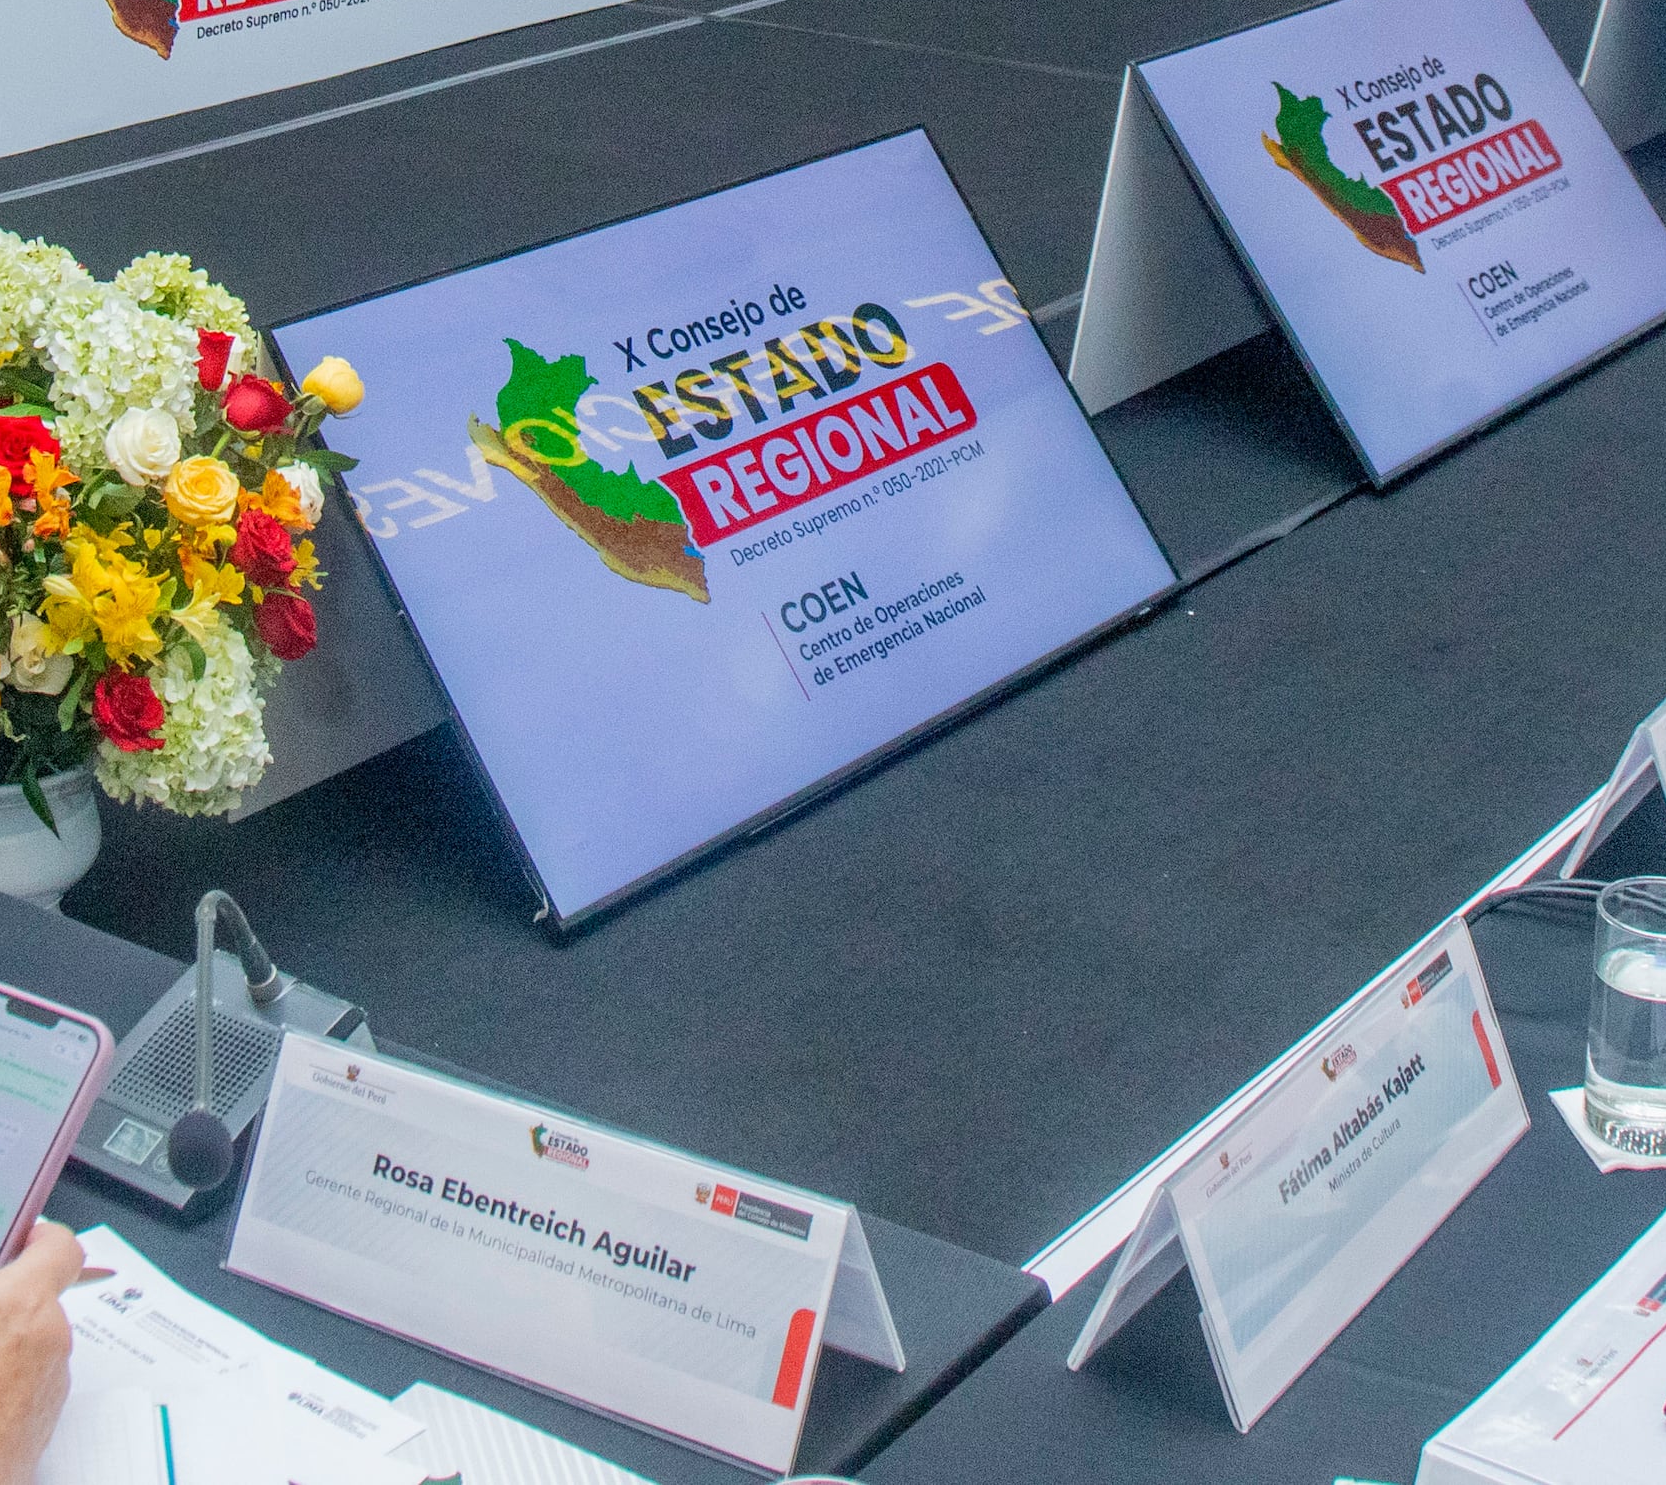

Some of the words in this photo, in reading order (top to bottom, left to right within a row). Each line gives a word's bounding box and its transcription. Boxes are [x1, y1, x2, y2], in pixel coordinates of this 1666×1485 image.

[197, 17, 244, 40] Decreto
[246, 6, 299, 31] Supremo
[1336, 82, 1358, 110] X
[1353, 60, 1423, 105] Consejo
[1423, 54, 1446, 79] de
[1353, 72, 1514, 175] ESTADO
[1399, 129, 1556, 224] REGIONAL
[1431, 227, 1467, 251] Decreto
[1464, 210, 1504, 234] Supremo
[1468, 260, 1520, 300] COEN
[1484, 297, 1515, 320] Centro
[1514, 290, 1527, 305] de
[1524, 266, 1574, 298] Operaciones
[1495, 322, 1509, 338] de
[1507, 297, 1558, 331] Emergencia
[1554, 279, 1590, 305] Nacional
[612, 339, 647, 373] X
[646, 299, 765, 361] Consejo
[768, 283, 807, 316] de
[632, 302, 909, 461] ESTADO
[690, 371, 967, 531] REGIONAL
[729, 530, 793, 567] Decreto
[792, 499, 862, 538] Supremo
[882, 439, 985, 498] 050-2021-PCM
[780, 570, 869, 634] COEN
[799, 625, 853, 662] Centro
[854, 614, 874, 635] de
[874, 570, 965, 626] Operaciones
[813, 665, 835, 686] de
[833, 622, 925, 675] Emergencia
[923, 585, 987, 631] Nacional
[351, 1083, 367, 1098] del
[1277, 1145, 1333, 1206] Fátima
[1332, 1092, 1385, 1157] Altabás
[1382, 1052, 1427, 1105] Kajatt
[546, 1147, 589, 1168] REGIONAL
[547, 1135, 589, 1158] ESTADO
[1327, 1157, 1363, 1195] Ministra
[1361, 1145, 1374, 1161] de
[1371, 1118, 1403, 1151] Cultura
[304, 1168, 361, 1202] Gerente
[364, 1188, 429, 1228] Regional
[430, 1208, 449, 1231] de
[452, 1214, 466, 1236] la
[468, 1221, 575, 1278] Municipalidad
[579, 1255, 689, 1315] Metropolitana
[693, 1299, 713, 1323] de
[716, 1304, 757, 1340] Lima
[372, 1152, 434, 1195] Rosa
[440, 1175, 587, 1249] Ebentreich
[592, 1228, 697, 1284] Aguilar
[296, 1396, 325, 1417] LIMA
